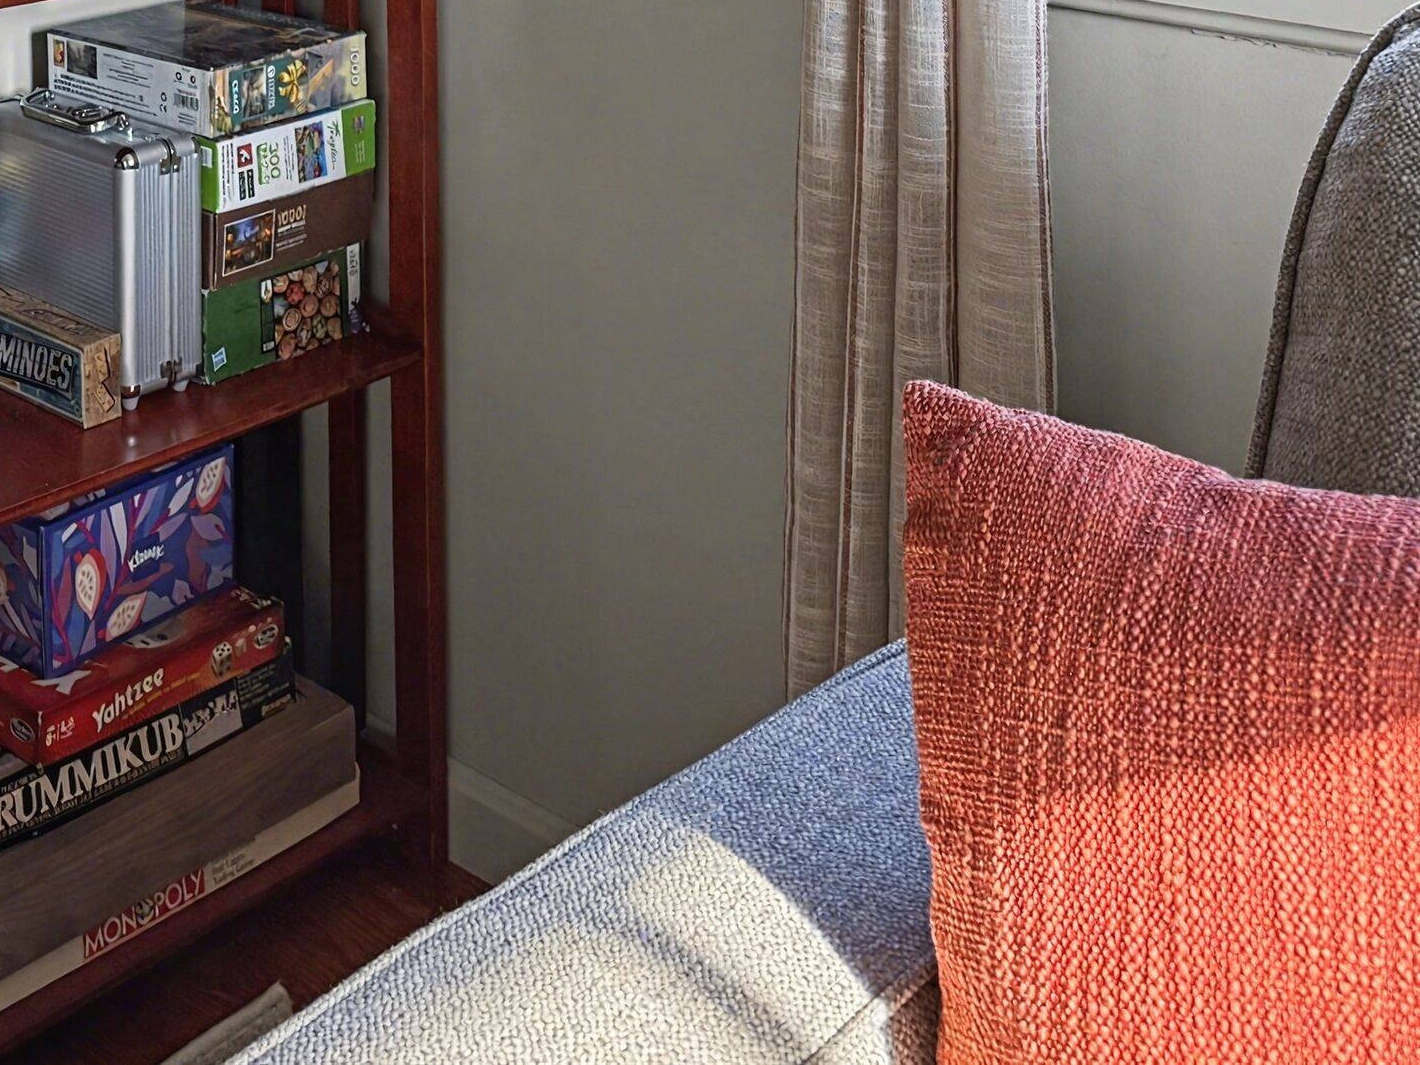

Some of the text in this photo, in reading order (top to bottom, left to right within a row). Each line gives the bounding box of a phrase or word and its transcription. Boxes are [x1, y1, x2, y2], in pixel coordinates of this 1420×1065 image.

[269, 141, 281, 179] 300
[92, 668, 165, 733] Yahtzee
[84, 868, 204, 957] MONOPOLY
